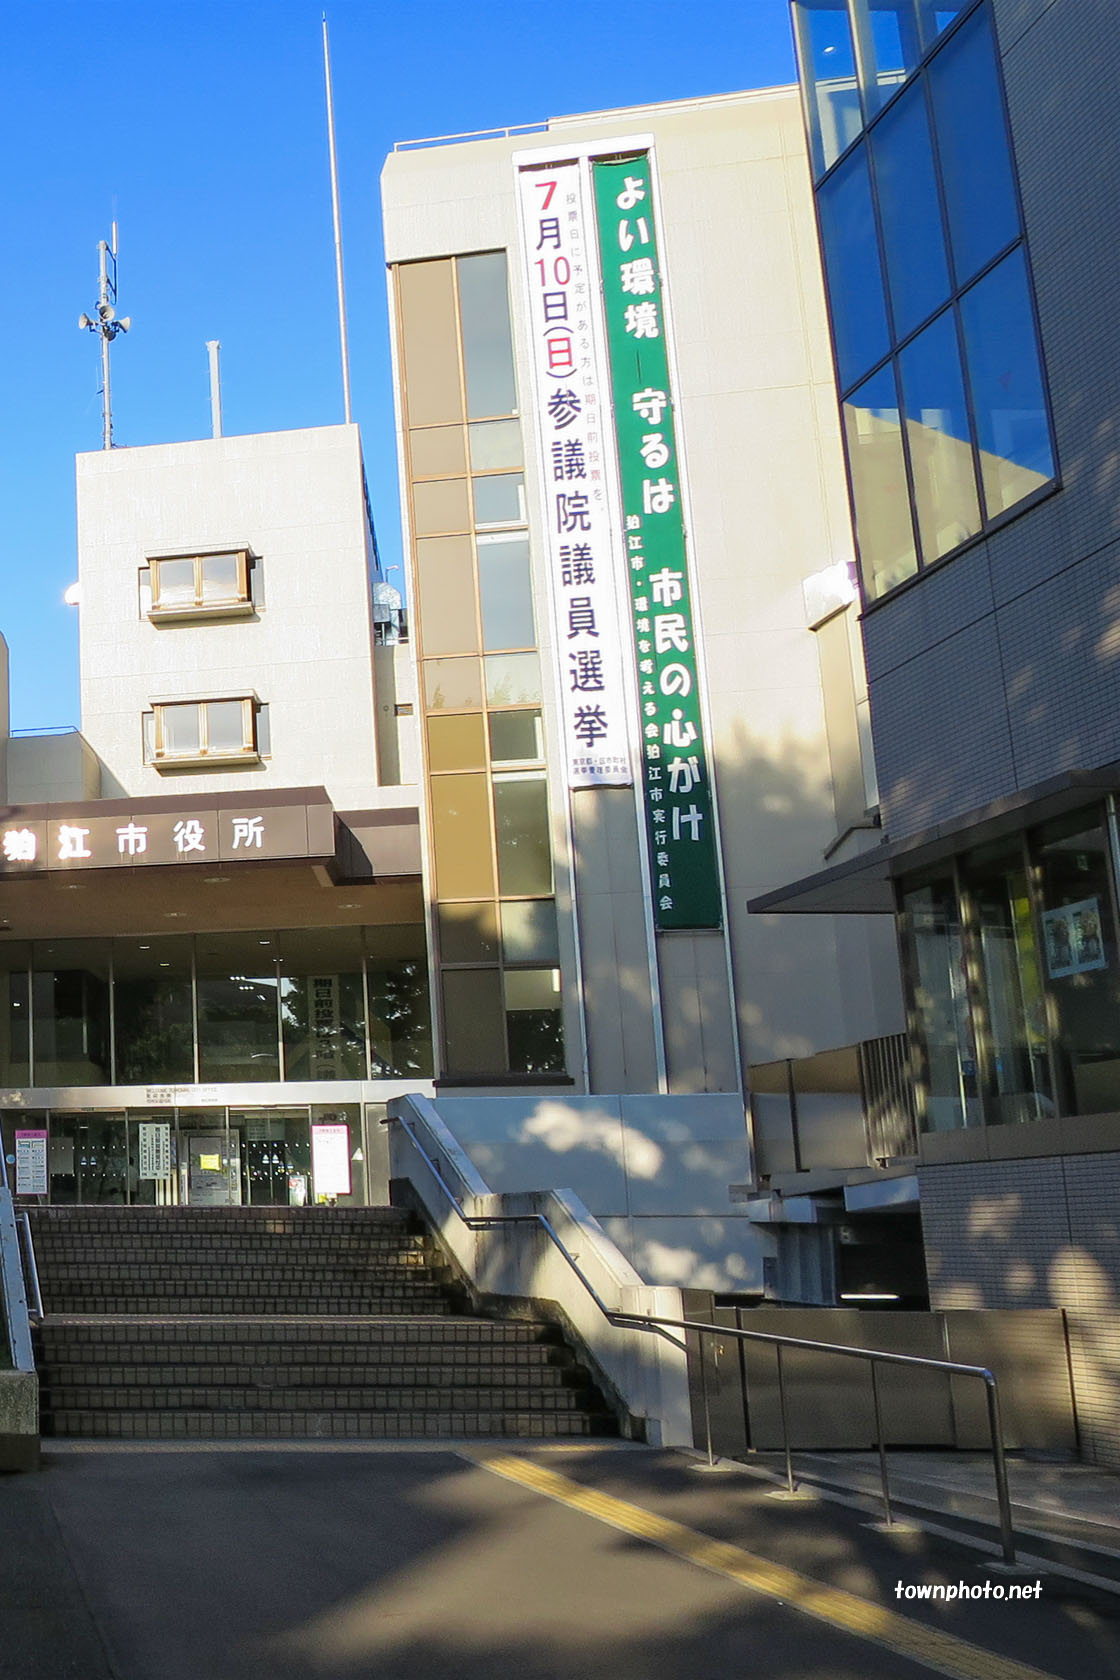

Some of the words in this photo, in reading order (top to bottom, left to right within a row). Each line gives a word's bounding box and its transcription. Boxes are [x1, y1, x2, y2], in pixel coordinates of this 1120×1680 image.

[615, 175, 660, 339] よい環境
[631, 386, 676, 515] 守るは
[648, 566, 704, 842] 市民の心がけ
